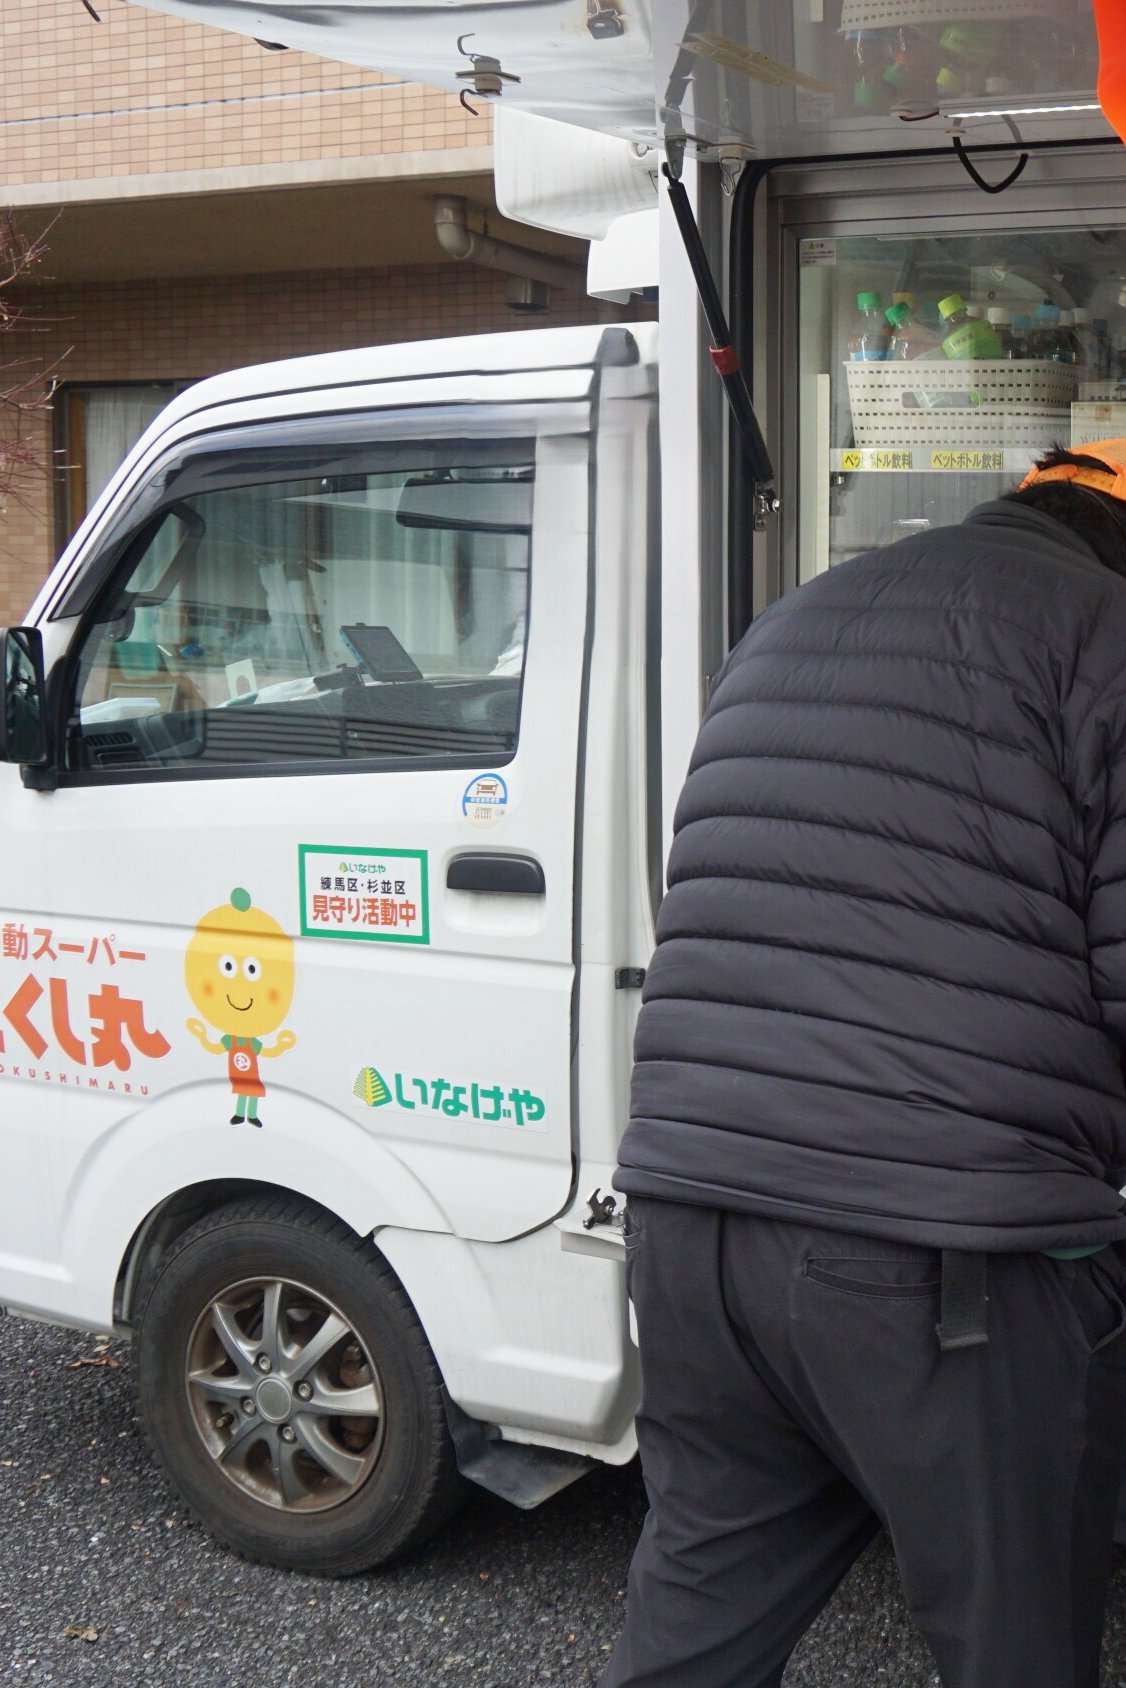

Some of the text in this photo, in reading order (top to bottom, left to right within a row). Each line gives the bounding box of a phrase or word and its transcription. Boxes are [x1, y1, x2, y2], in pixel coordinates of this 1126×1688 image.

[845, 451, 911, 468] ペットル飲料
[933, 451, 1001, 468] ペットボトル飲料
[320, 876, 406, 895] 練馬区・杉並区
[312, 894, 416, 928] 見守り活動中
[2, 922, 146, 967] 動スーパー
[0, 972, 172, 1072] くし丸
[394, 1072, 546, 1126] いなげや
